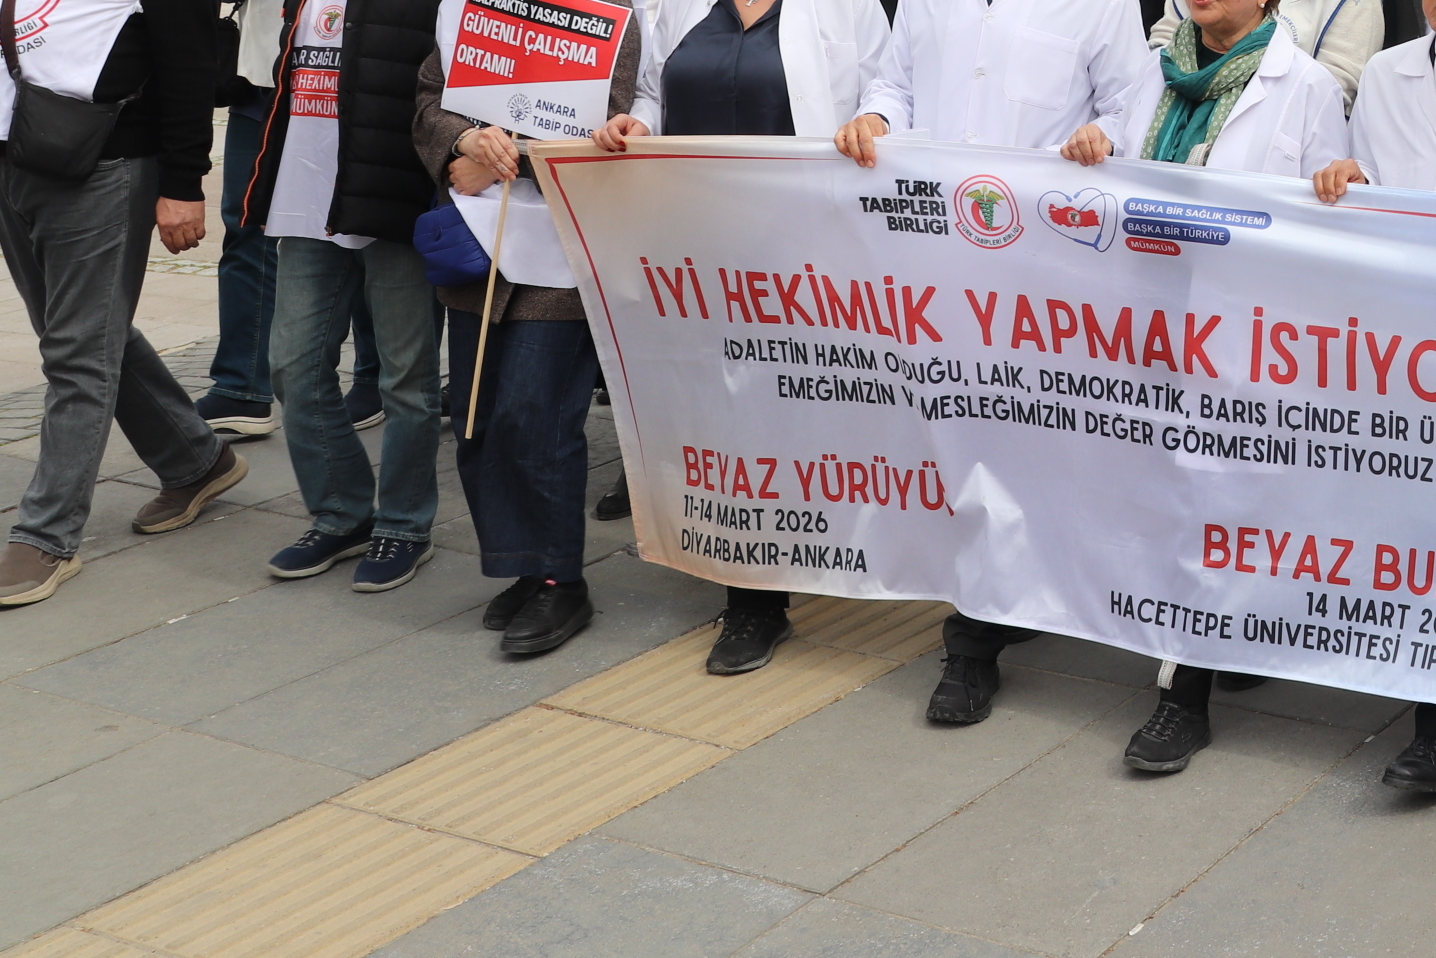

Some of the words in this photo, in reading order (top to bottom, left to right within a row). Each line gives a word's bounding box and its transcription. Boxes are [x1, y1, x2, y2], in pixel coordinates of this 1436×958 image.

[530, 4, 571, 28] YASASI
[571, 15, 614, 38] DEĞİL!
[17, 35, 47, 55] DASI
[463, 11, 525, 47] GÜVENLİ
[524, 29, 598, 68] ÇALIŞMA
[308, 48, 341, 67] SAĞLI
[456, 43, 516, 79] ORTAMI!
[535, 99, 576, 119] ANKARA
[533, 115, 561, 132] TABİP
[563, 124, 594, 139] ODAS
[895, 178, 943, 199] TÜRK
[859, 197, 947, 218] TABİPLERİ
[1128, 201, 1164, 216] BAŞKA
[1166, 205, 1183, 217] BİR
[1185, 206, 1223, 222] SAĞLIK
[1224, 211, 1267, 227] SİSTEMİ
[887, 215, 949, 236] BİRLİĞİ
[960, 223, 973, 238] TÜRK
[974, 236, 1003, 245] TABİPLERİ
[1127, 222, 1163, 236] BAŞKA
[1165, 223, 1182, 236] BİR
[1183, 224, 1225, 241] TÜRKİYE
[1130, 239, 1175, 254] MÜMKÜN
[639, 256, 709, 320] İYİ
[717, 263, 944, 346] HEKİMLİK
[963, 288, 1222, 379] YAPMAK
[814, 342, 878, 372] HAKİM
[976, 359, 1031, 394] LAİK,
[1039, 368, 1191, 419] DEMOKRATİK,
[1199, 393, 1267, 427] BARIŞ
[1277, 399, 1361, 437] İÇİNDE
[1371, 410, 1409, 441] BİR
[778, 374, 897, 406] EMEĞİMİZİN
[901, 385, 919, 410] V
[920, 393, 1077, 432] MESLEĞİMİZİN
[1084, 410, 1154, 447] DEĞER
[1161, 425, 1298, 466] GÖRMESİNİ
[1306, 439, 1435, 483] İSTİYORUZ
[682, 445, 780, 501] BEYAZ
[793, 453, 954, 517] YÜRÜYÜ
[683, 495, 713, 522] 11-14
[716, 504, 765, 532] MART
[774, 509, 829, 534] 2026
[681, 527, 868, 573] DİYARBAKIR-ANKARA
[1202, 522, 1354, 586] BEYAZ
[1110, 590, 1234, 641] HACETTEPE
[1243, 613, 1402, 665] ÜNİVERSİTESİ
[1306, 591, 1328, 619] 14
[1338, 596, 1411, 632] MART
